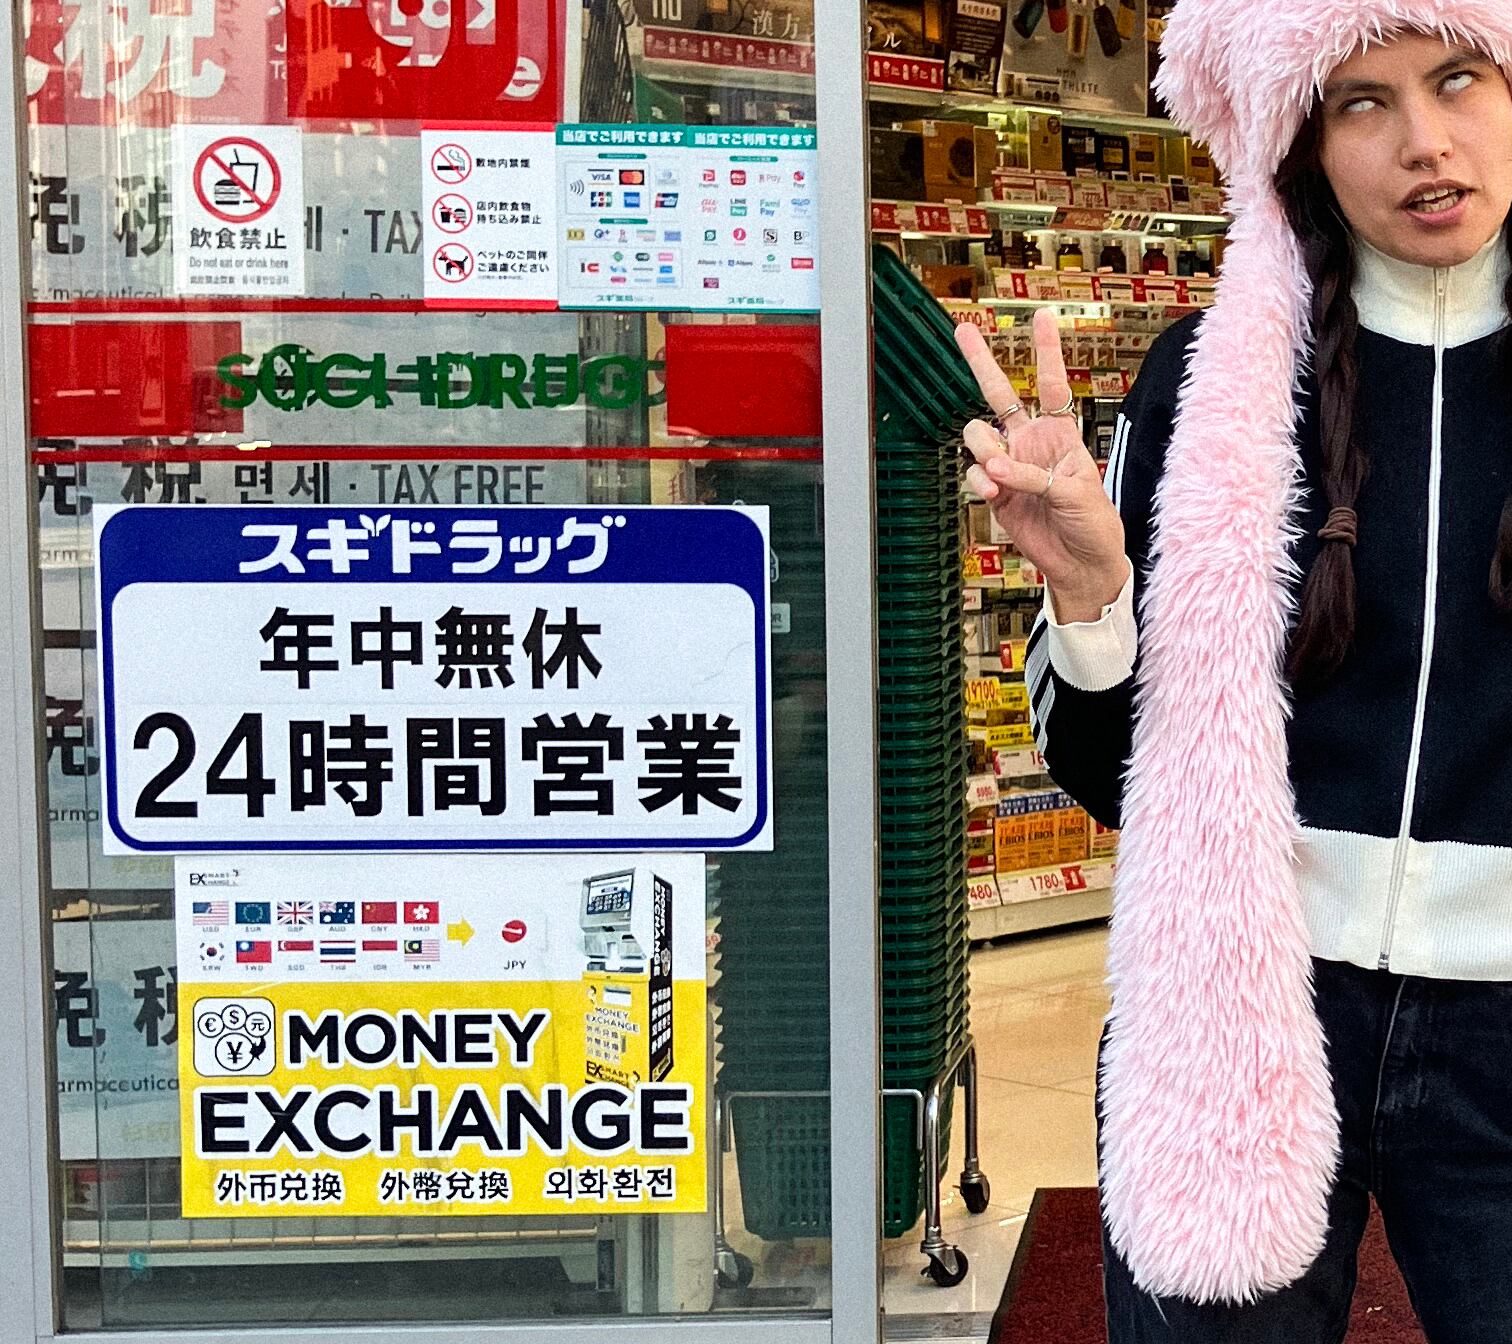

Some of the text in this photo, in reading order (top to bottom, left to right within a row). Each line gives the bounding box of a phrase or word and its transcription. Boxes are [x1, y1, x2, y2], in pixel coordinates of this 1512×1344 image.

[563, 129, 684, 144] 当店でご利用できます
[694, 132, 816, 147] 当店でご利用できます
[476, 201, 532, 212] 店内飲食物
[476, 214, 542, 225] 持ち込み禁止
[190, 227, 287, 250] 飲食禁止
[189, 256, 202, 267] Do
[203, 257, 217, 268] not
[235, 259, 244, 268] or
[246, 257, 268, 268] drink
[270, 258, 289, 269] here
[477, 250, 549, 260] ペットのご同伴
[477, 262, 550, 273] ご遠慮ください
[372, 463, 441, 504] TAX
[454, 464, 546, 504] FREE
[238, 513, 627, 575] スギドラッグ
[258, 606, 604, 692] 年中無休
[133, 712, 743, 820] 24時間営業
[1029, 873, 1060, 891] 1780
[502, 960, 528, 971] JPY
[289, 1012, 547, 1066] MONEY
[199, 1087, 690, 1156] EXCHANGE
[217, 1172, 343, 1203] 外币兑换
[544, 1168, 675, 1201] 외화환전
